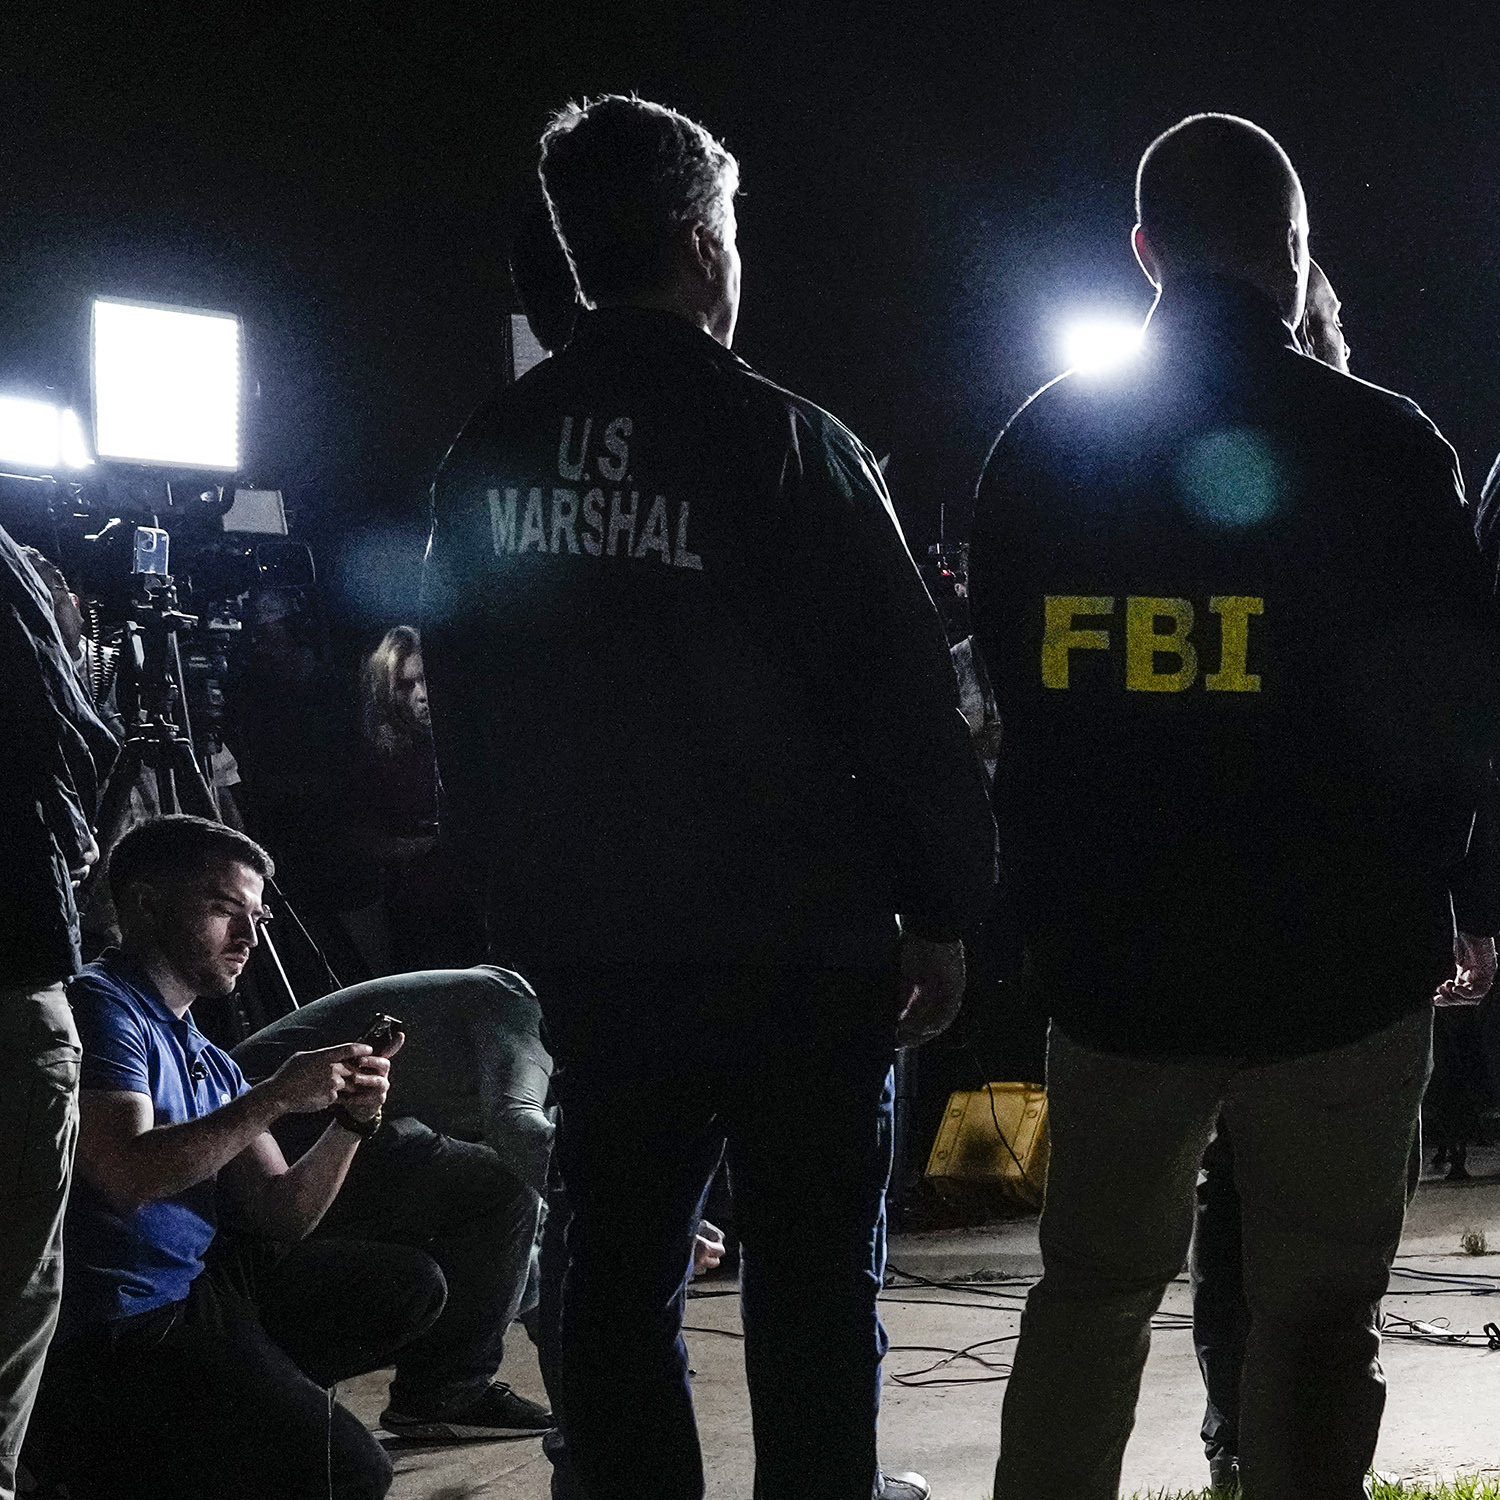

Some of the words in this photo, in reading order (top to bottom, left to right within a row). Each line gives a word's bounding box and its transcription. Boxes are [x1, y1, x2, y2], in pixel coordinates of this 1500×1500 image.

[558, 416, 633, 482] U.S.
[487, 487, 703, 570] MARSHAL
[1042, 595, 1264, 692] FBI
